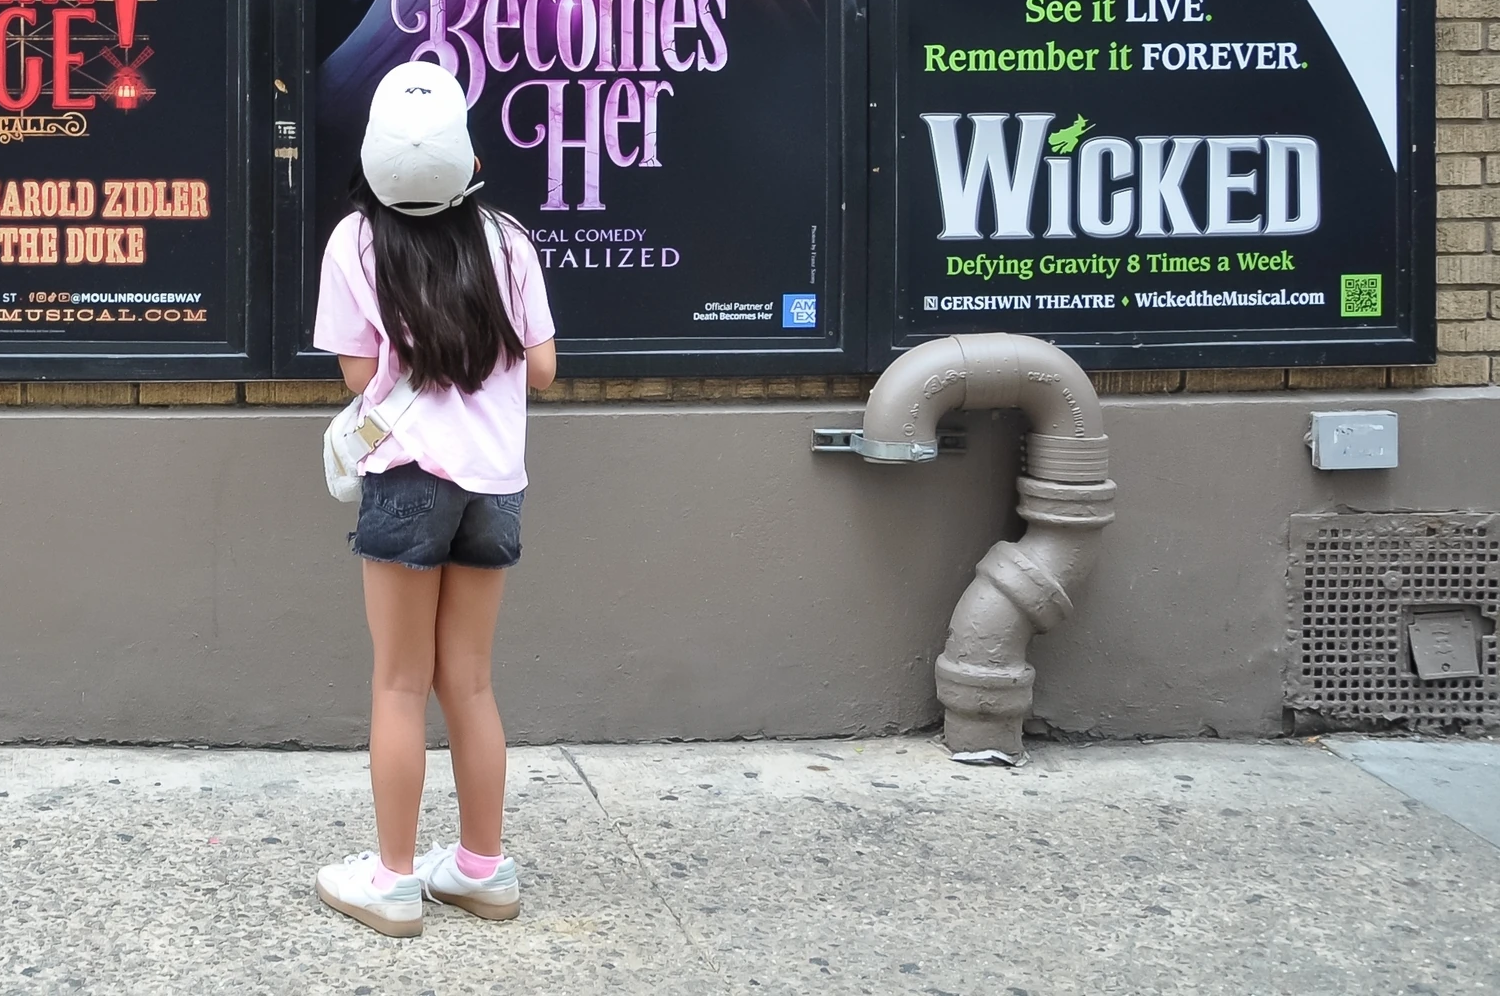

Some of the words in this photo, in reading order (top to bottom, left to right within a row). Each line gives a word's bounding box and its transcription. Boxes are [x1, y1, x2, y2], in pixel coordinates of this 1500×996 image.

[924, 41, 1099, 72] Remember
[1109, 41, 1133, 71] it
[1142, 42, 1308, 71] FOREVER.
[501, 78, 674, 210] Her
[102, 181, 210, 219] ZIDLER
[65, 227, 145, 264] DUKE
[575, 228, 646, 242] COMEDY
[946, 253, 1034, 280] Defying
[1039, 253, 1120, 279] Gravity
[1127, 255, 1140, 274] 8
[1147, 253, 1211, 273] Times
[1217, 256, 1230, 272] a
[1237, 250, 1295, 271] Week
[3, 293, 17, 302] ST
[71, 293, 201, 303] @MOULINROUGEBWAY
[705, 302, 732, 311] Official
[764, 302, 773, 310] of
[941, 294, 1031, 311] GERSHWIN
[1036, 294, 1115, 309] THEATRE
[1135, 289, 1325, 308] WickedtheMusical.com
[693, 312, 718, 320] Death
[720, 312, 756, 320] Becomes
[758, 312, 773, 320] Her
